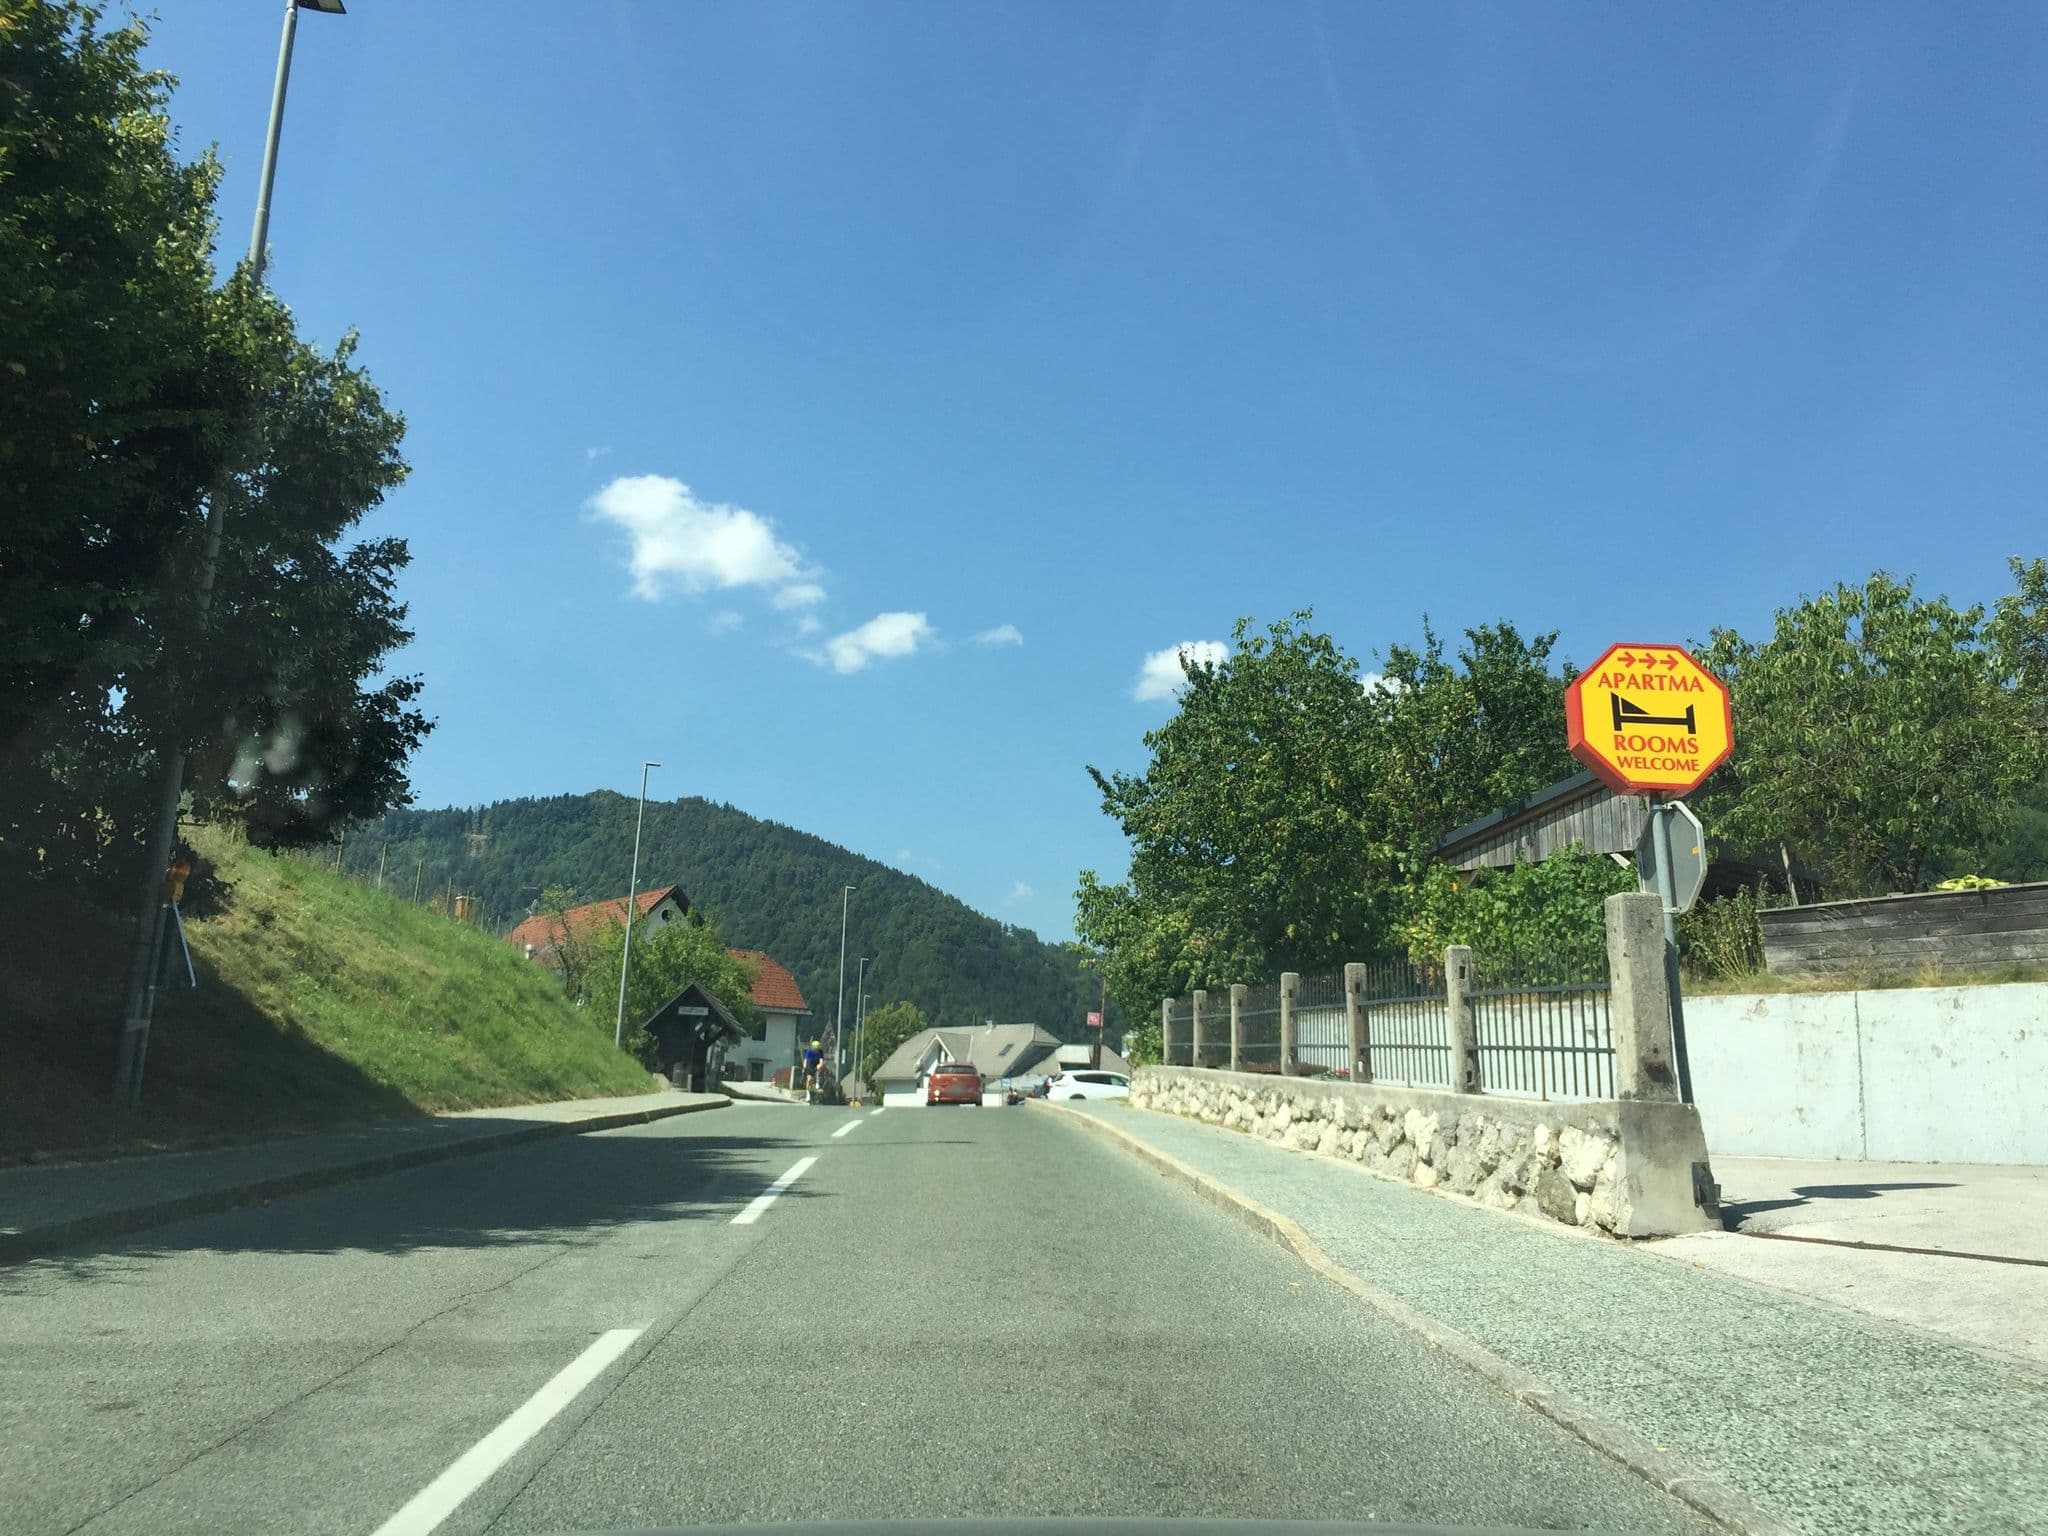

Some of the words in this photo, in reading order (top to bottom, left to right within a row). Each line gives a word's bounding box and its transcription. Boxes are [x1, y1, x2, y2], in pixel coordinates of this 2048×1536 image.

[1598, 672, 1705, 692] APARTMA
[1613, 734, 1699, 754] ROOMS
[1616, 755, 1700, 772] WELCOME
